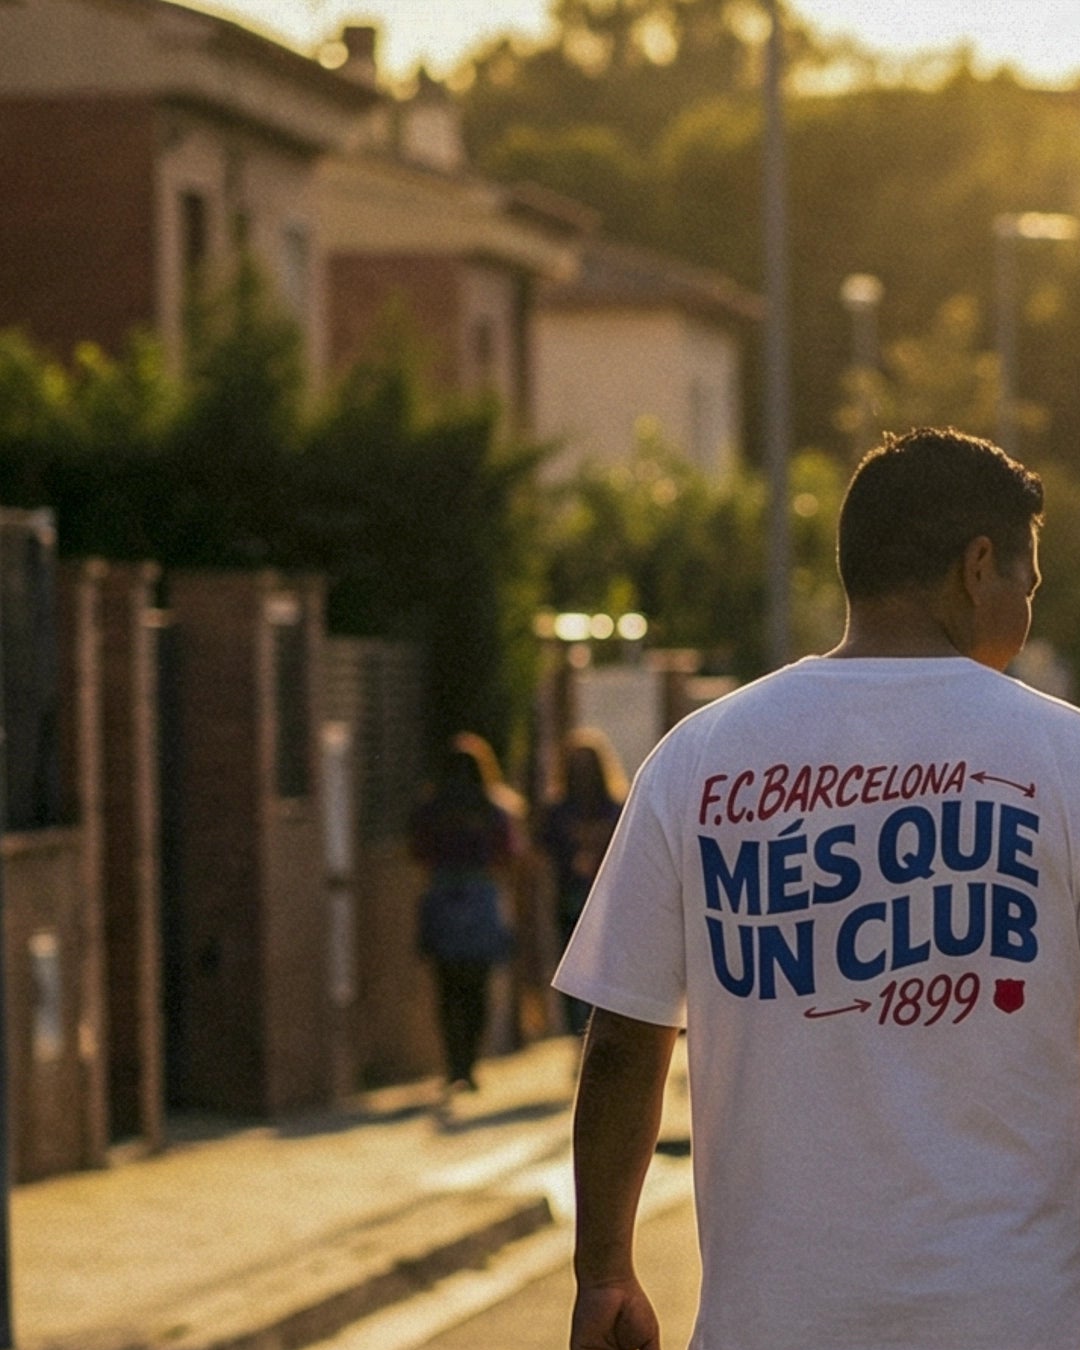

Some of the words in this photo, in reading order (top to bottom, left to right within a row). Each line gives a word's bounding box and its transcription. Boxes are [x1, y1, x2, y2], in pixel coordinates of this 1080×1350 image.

[698, 818, 861, 915] MÉS
[878, 801, 1039, 887] QUE
[705, 915, 816, 999] UN
[836, 882, 1038, 981] CLUB
[878, 972, 980, 1026] 1899
